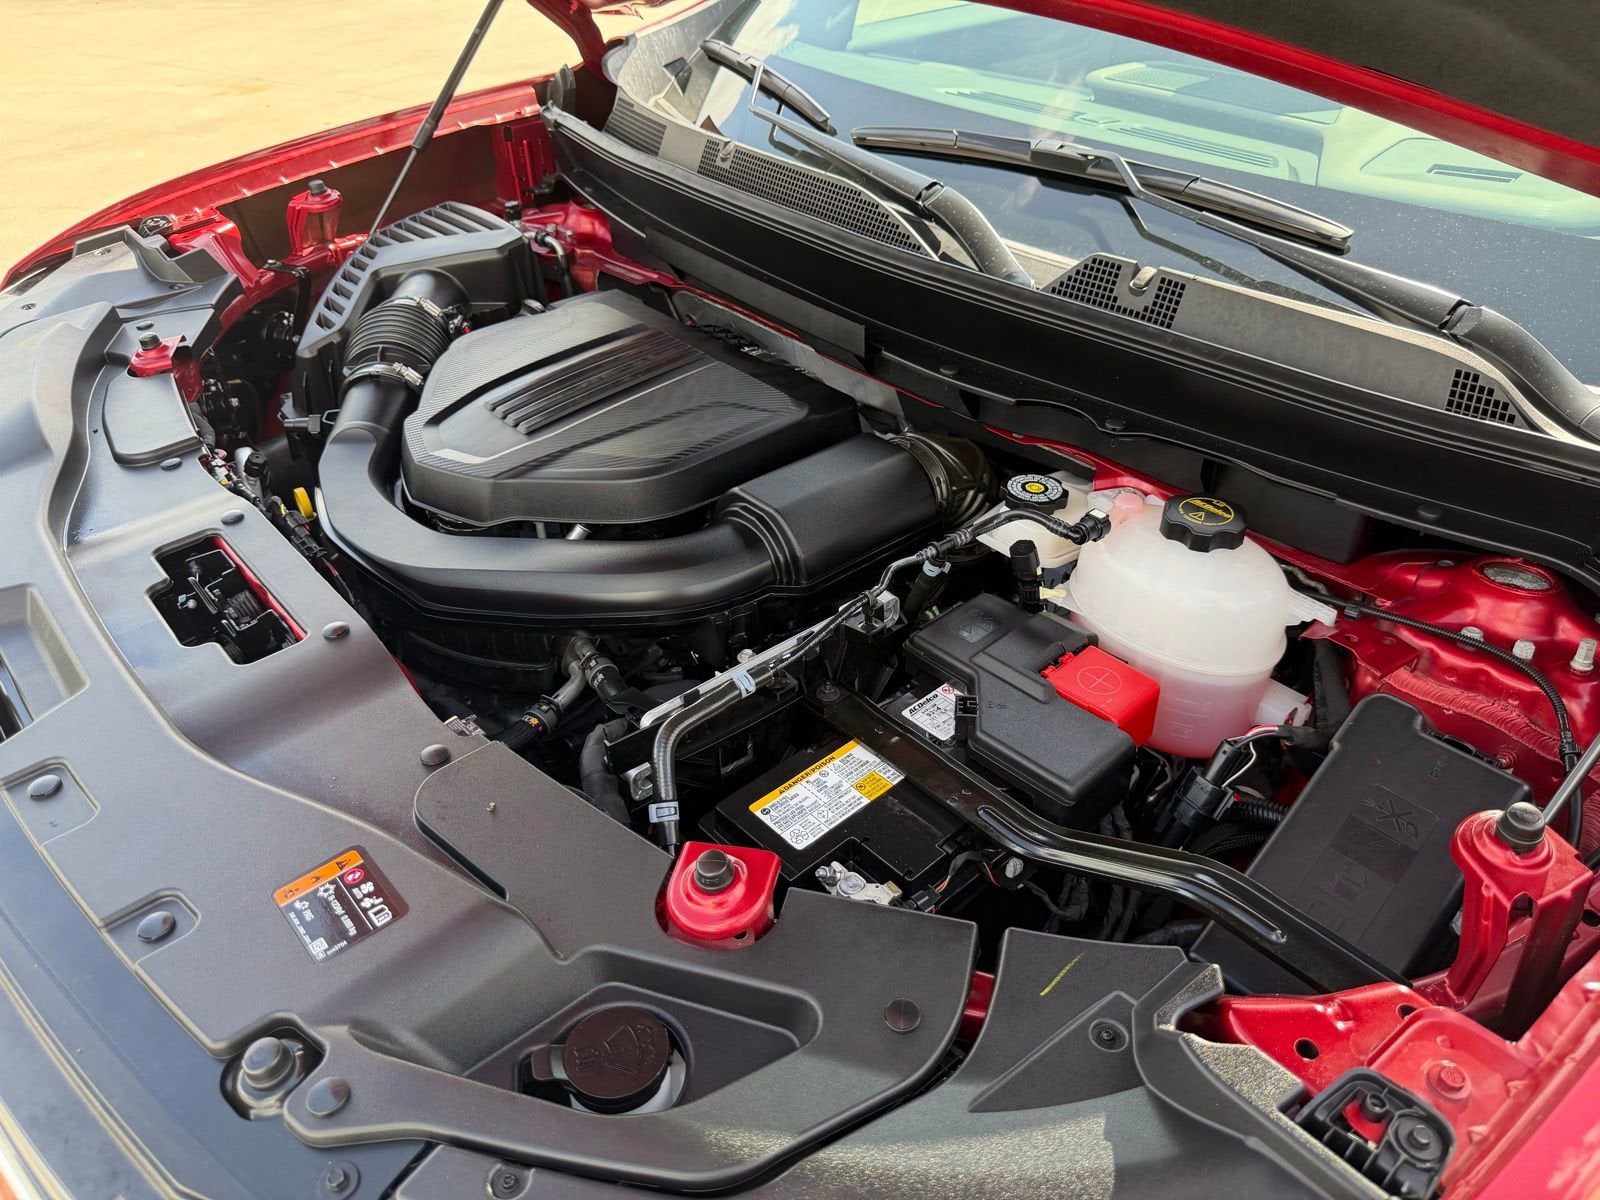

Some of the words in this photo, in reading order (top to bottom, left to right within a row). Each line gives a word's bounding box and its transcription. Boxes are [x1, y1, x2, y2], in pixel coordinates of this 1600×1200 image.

[1191, 499, 1231, 518] ACDelco
[908, 692, 939, 715] ACDelco
[783, 756, 836, 791] DANGER/POISON
